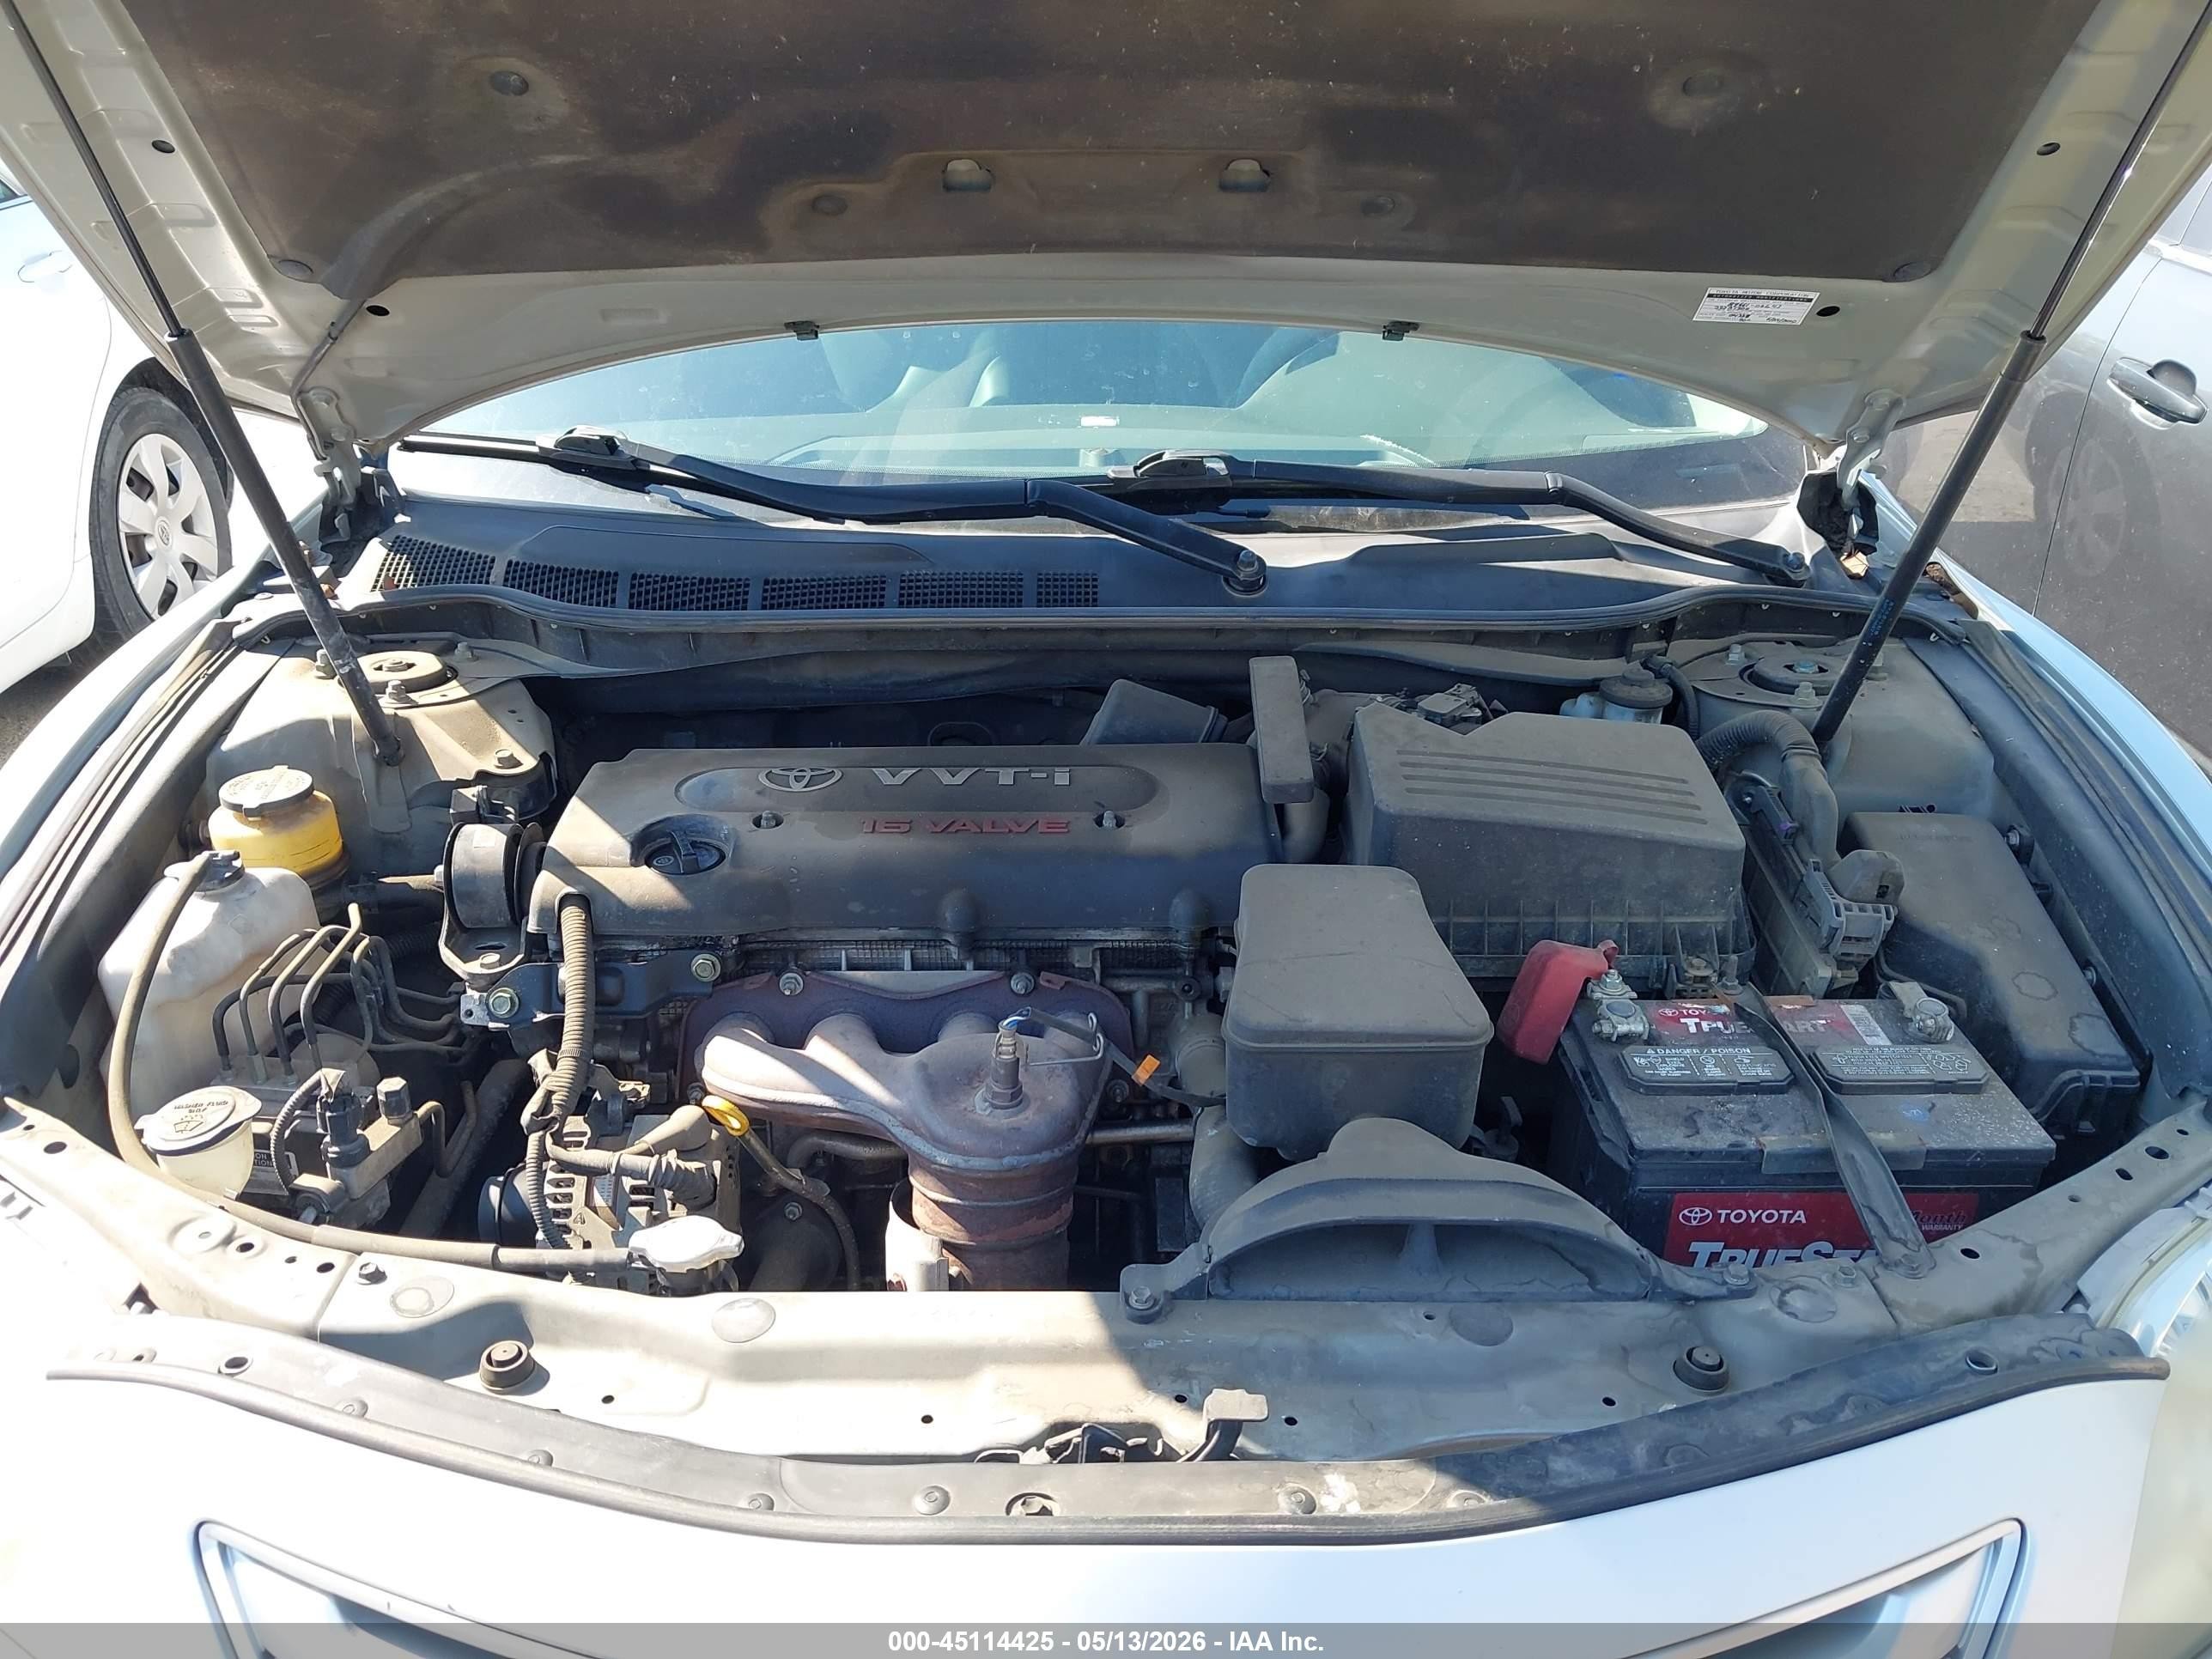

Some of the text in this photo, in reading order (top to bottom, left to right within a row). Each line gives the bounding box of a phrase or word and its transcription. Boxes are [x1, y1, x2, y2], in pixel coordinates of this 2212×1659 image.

[861, 818, 1070, 834] 16 VALVE
[1717, 1209, 1807, 1224] TOYOTA
